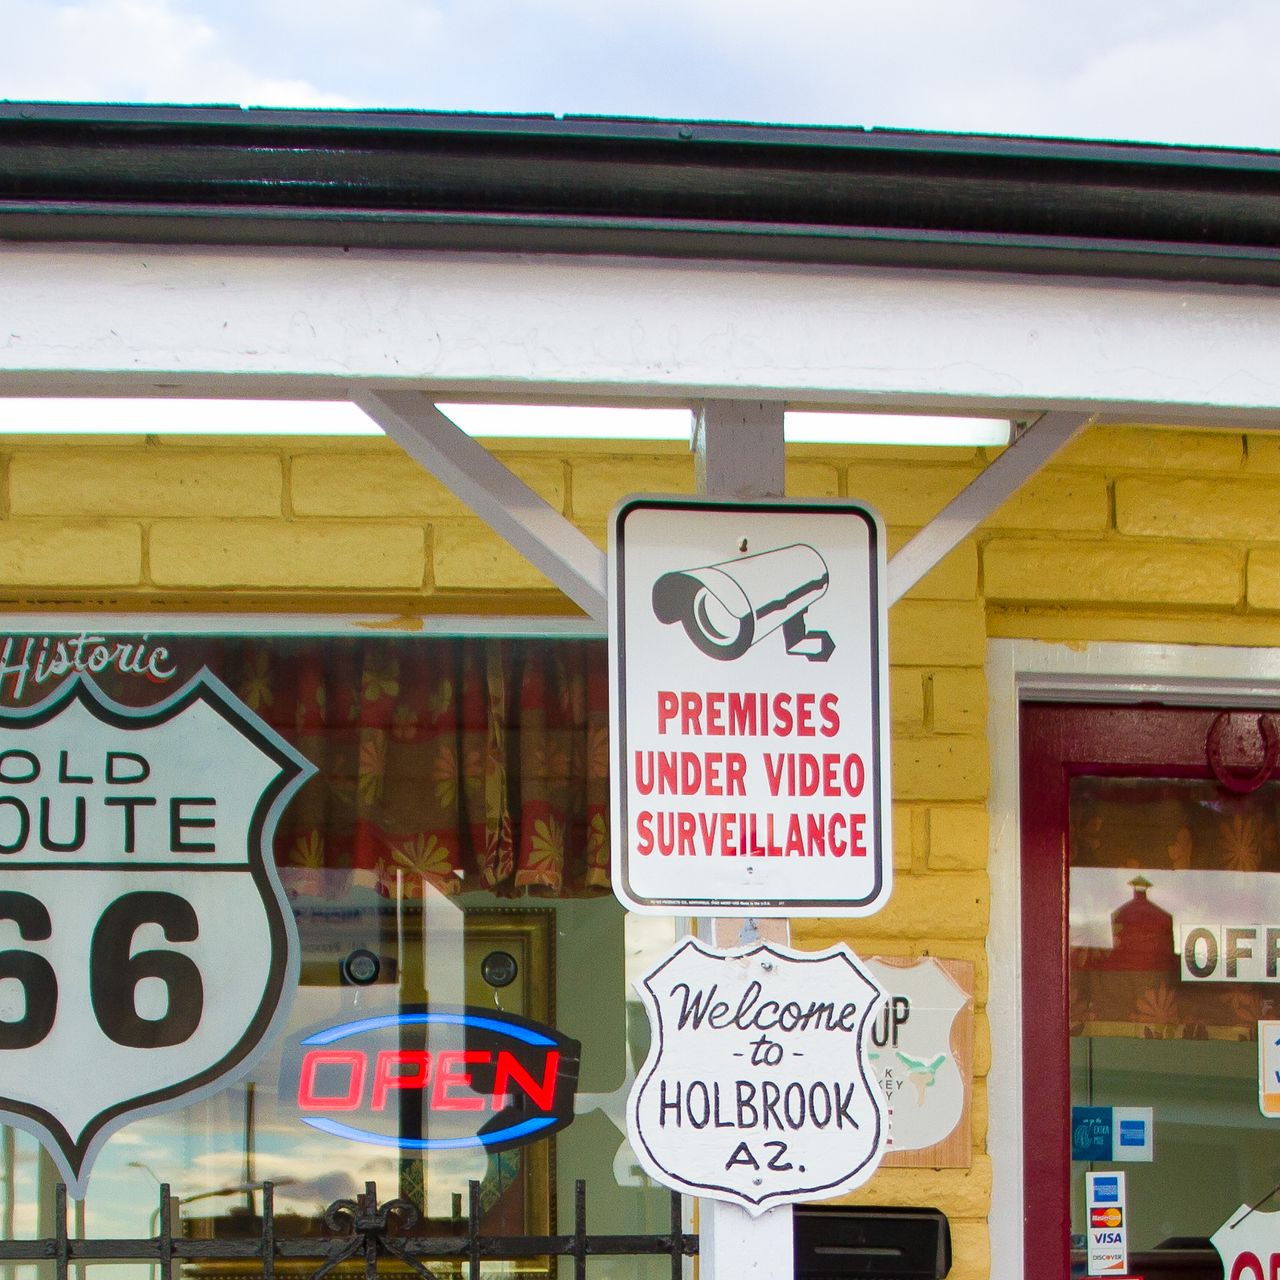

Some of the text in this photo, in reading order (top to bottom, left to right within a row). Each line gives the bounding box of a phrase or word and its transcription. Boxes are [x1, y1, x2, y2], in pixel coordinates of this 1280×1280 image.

[658, 691, 840, 738] PREMISES
[635, 750, 865, 797] UNDER VIDEO
[636, 810, 867, 858] SURVEILLANCE
[670, 981, 856, 1032] Welcome
[297, 1050, 561, 1112] OPEN
[659, 1080, 859, 1131] HOLBROOK
[1094, 1232, 1122, 1243] VISA
